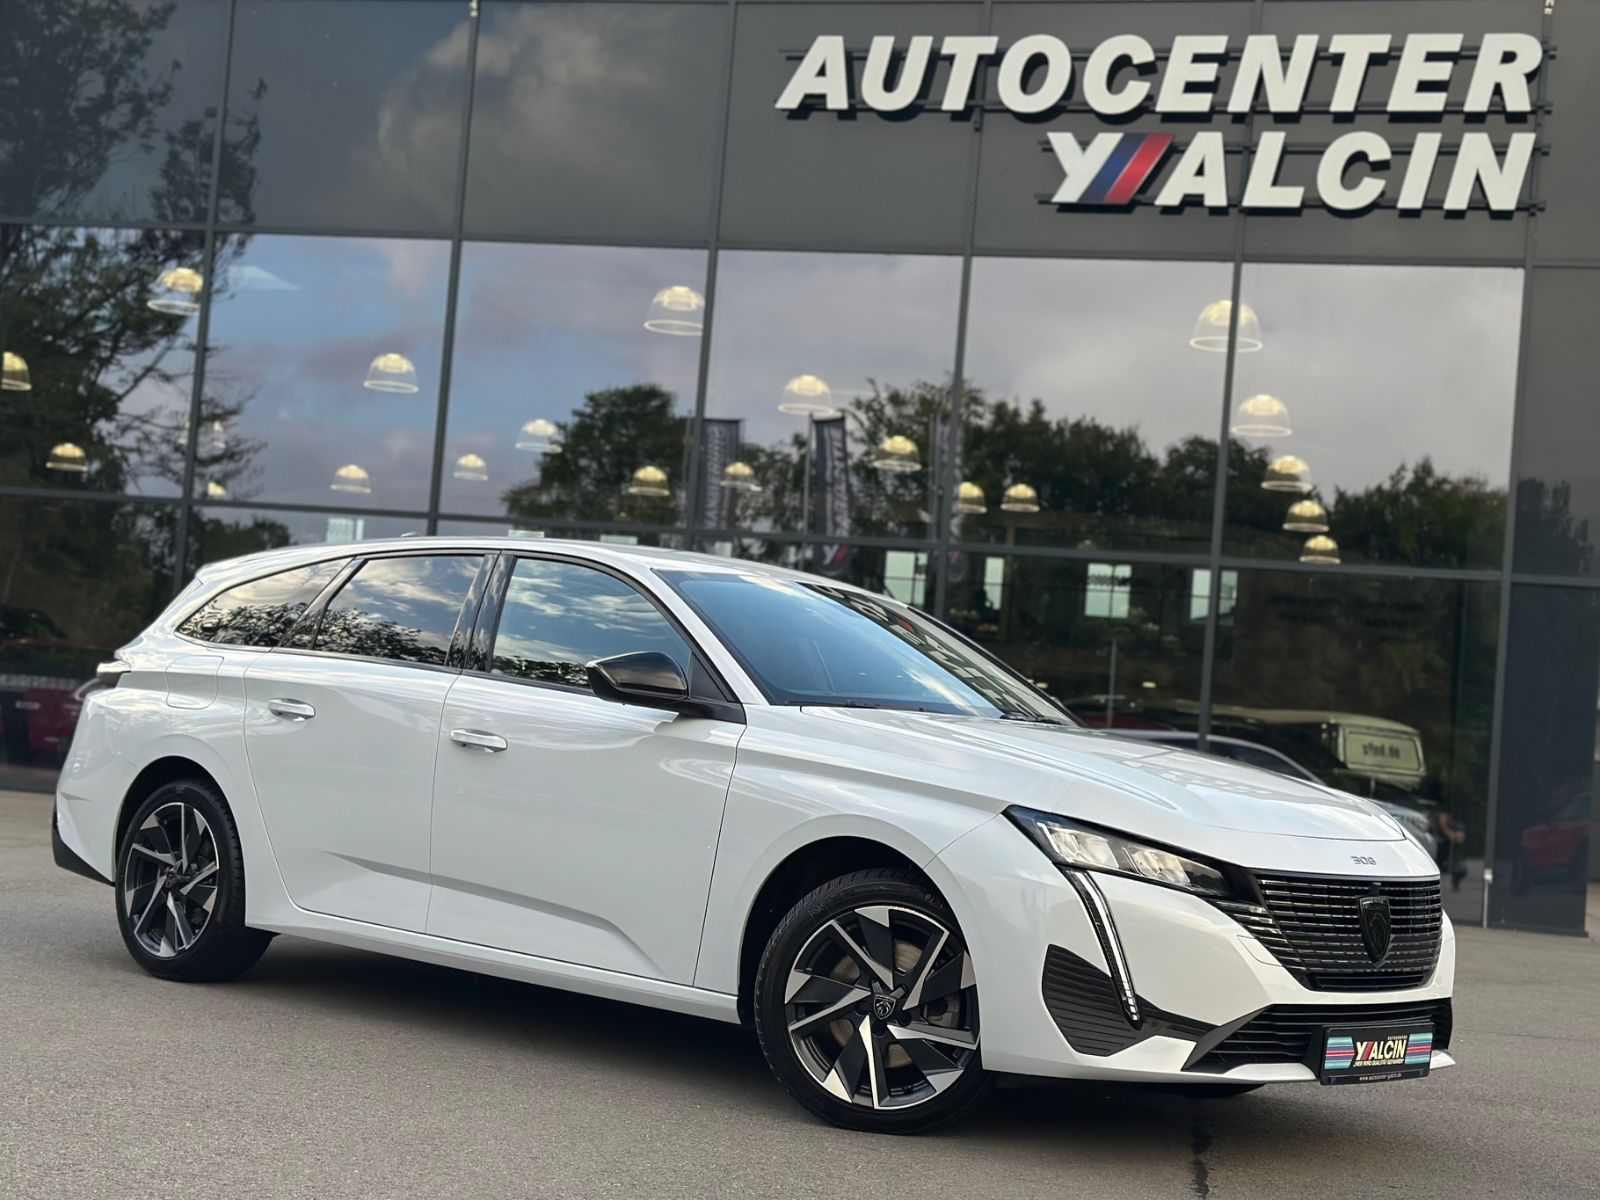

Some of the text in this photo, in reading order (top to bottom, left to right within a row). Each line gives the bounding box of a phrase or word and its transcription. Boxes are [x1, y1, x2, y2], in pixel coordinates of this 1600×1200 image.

[774, 33, 1544, 114] AUTOCENTER
[1046, 130, 1537, 211] YALCIN
[1350, 855, 1377, 866] 308
[1355, 1040, 1407, 1061] YALCIN
